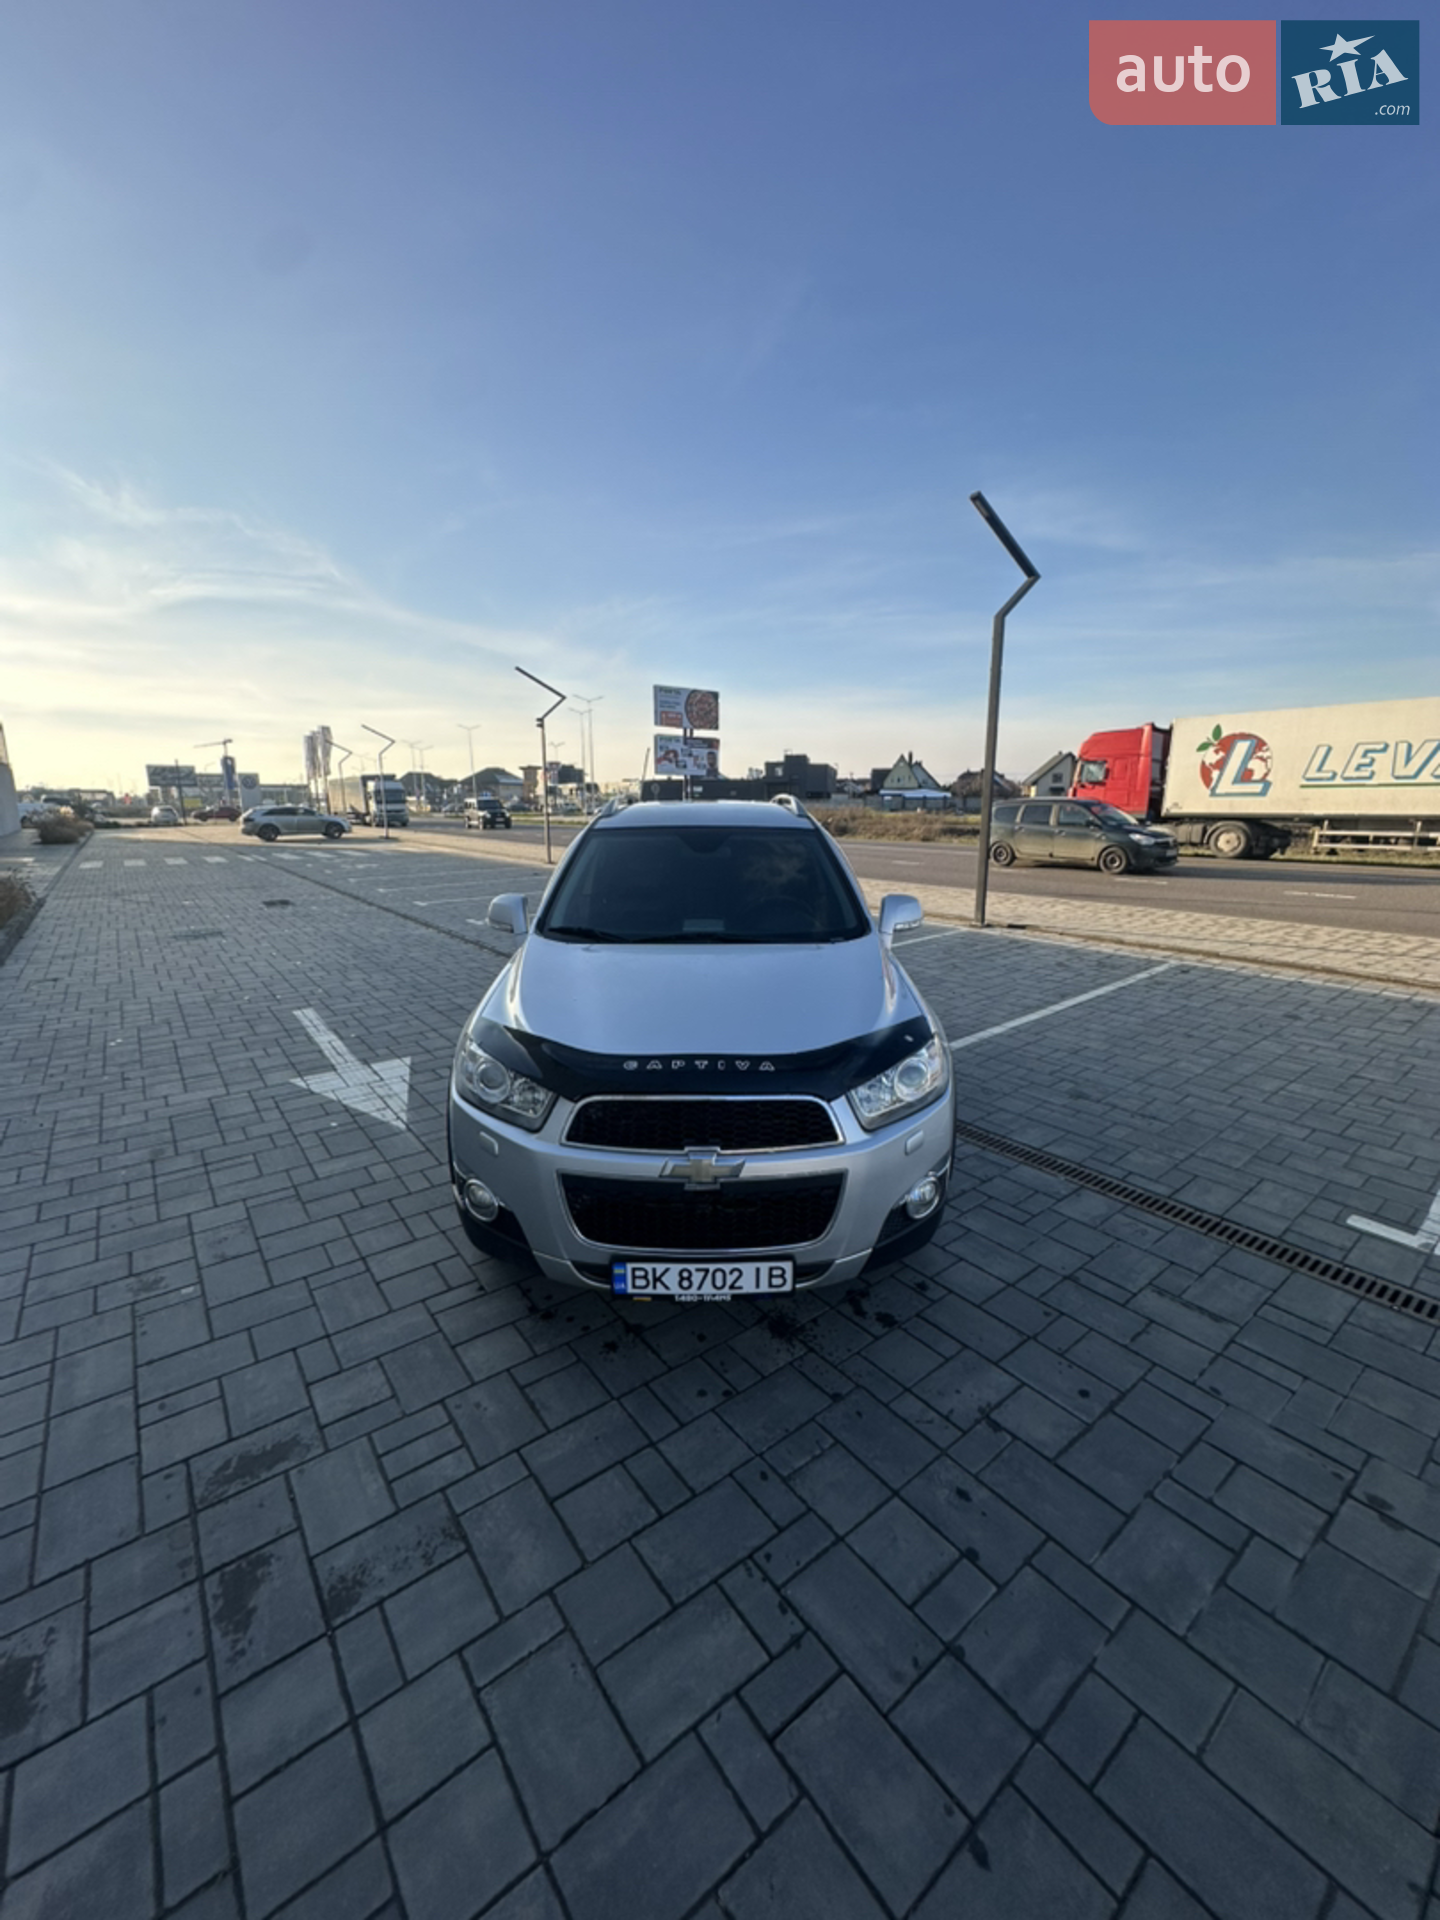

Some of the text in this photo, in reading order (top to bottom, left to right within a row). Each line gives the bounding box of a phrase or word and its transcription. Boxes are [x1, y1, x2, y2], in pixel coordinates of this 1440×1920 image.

[1209, 739, 1272, 797] L
[1303, 739, 1440, 781] LEV
[623, 1060, 775, 1071] CAPTIVA
[631, 1265, 787, 1291] BK 8702 IB
